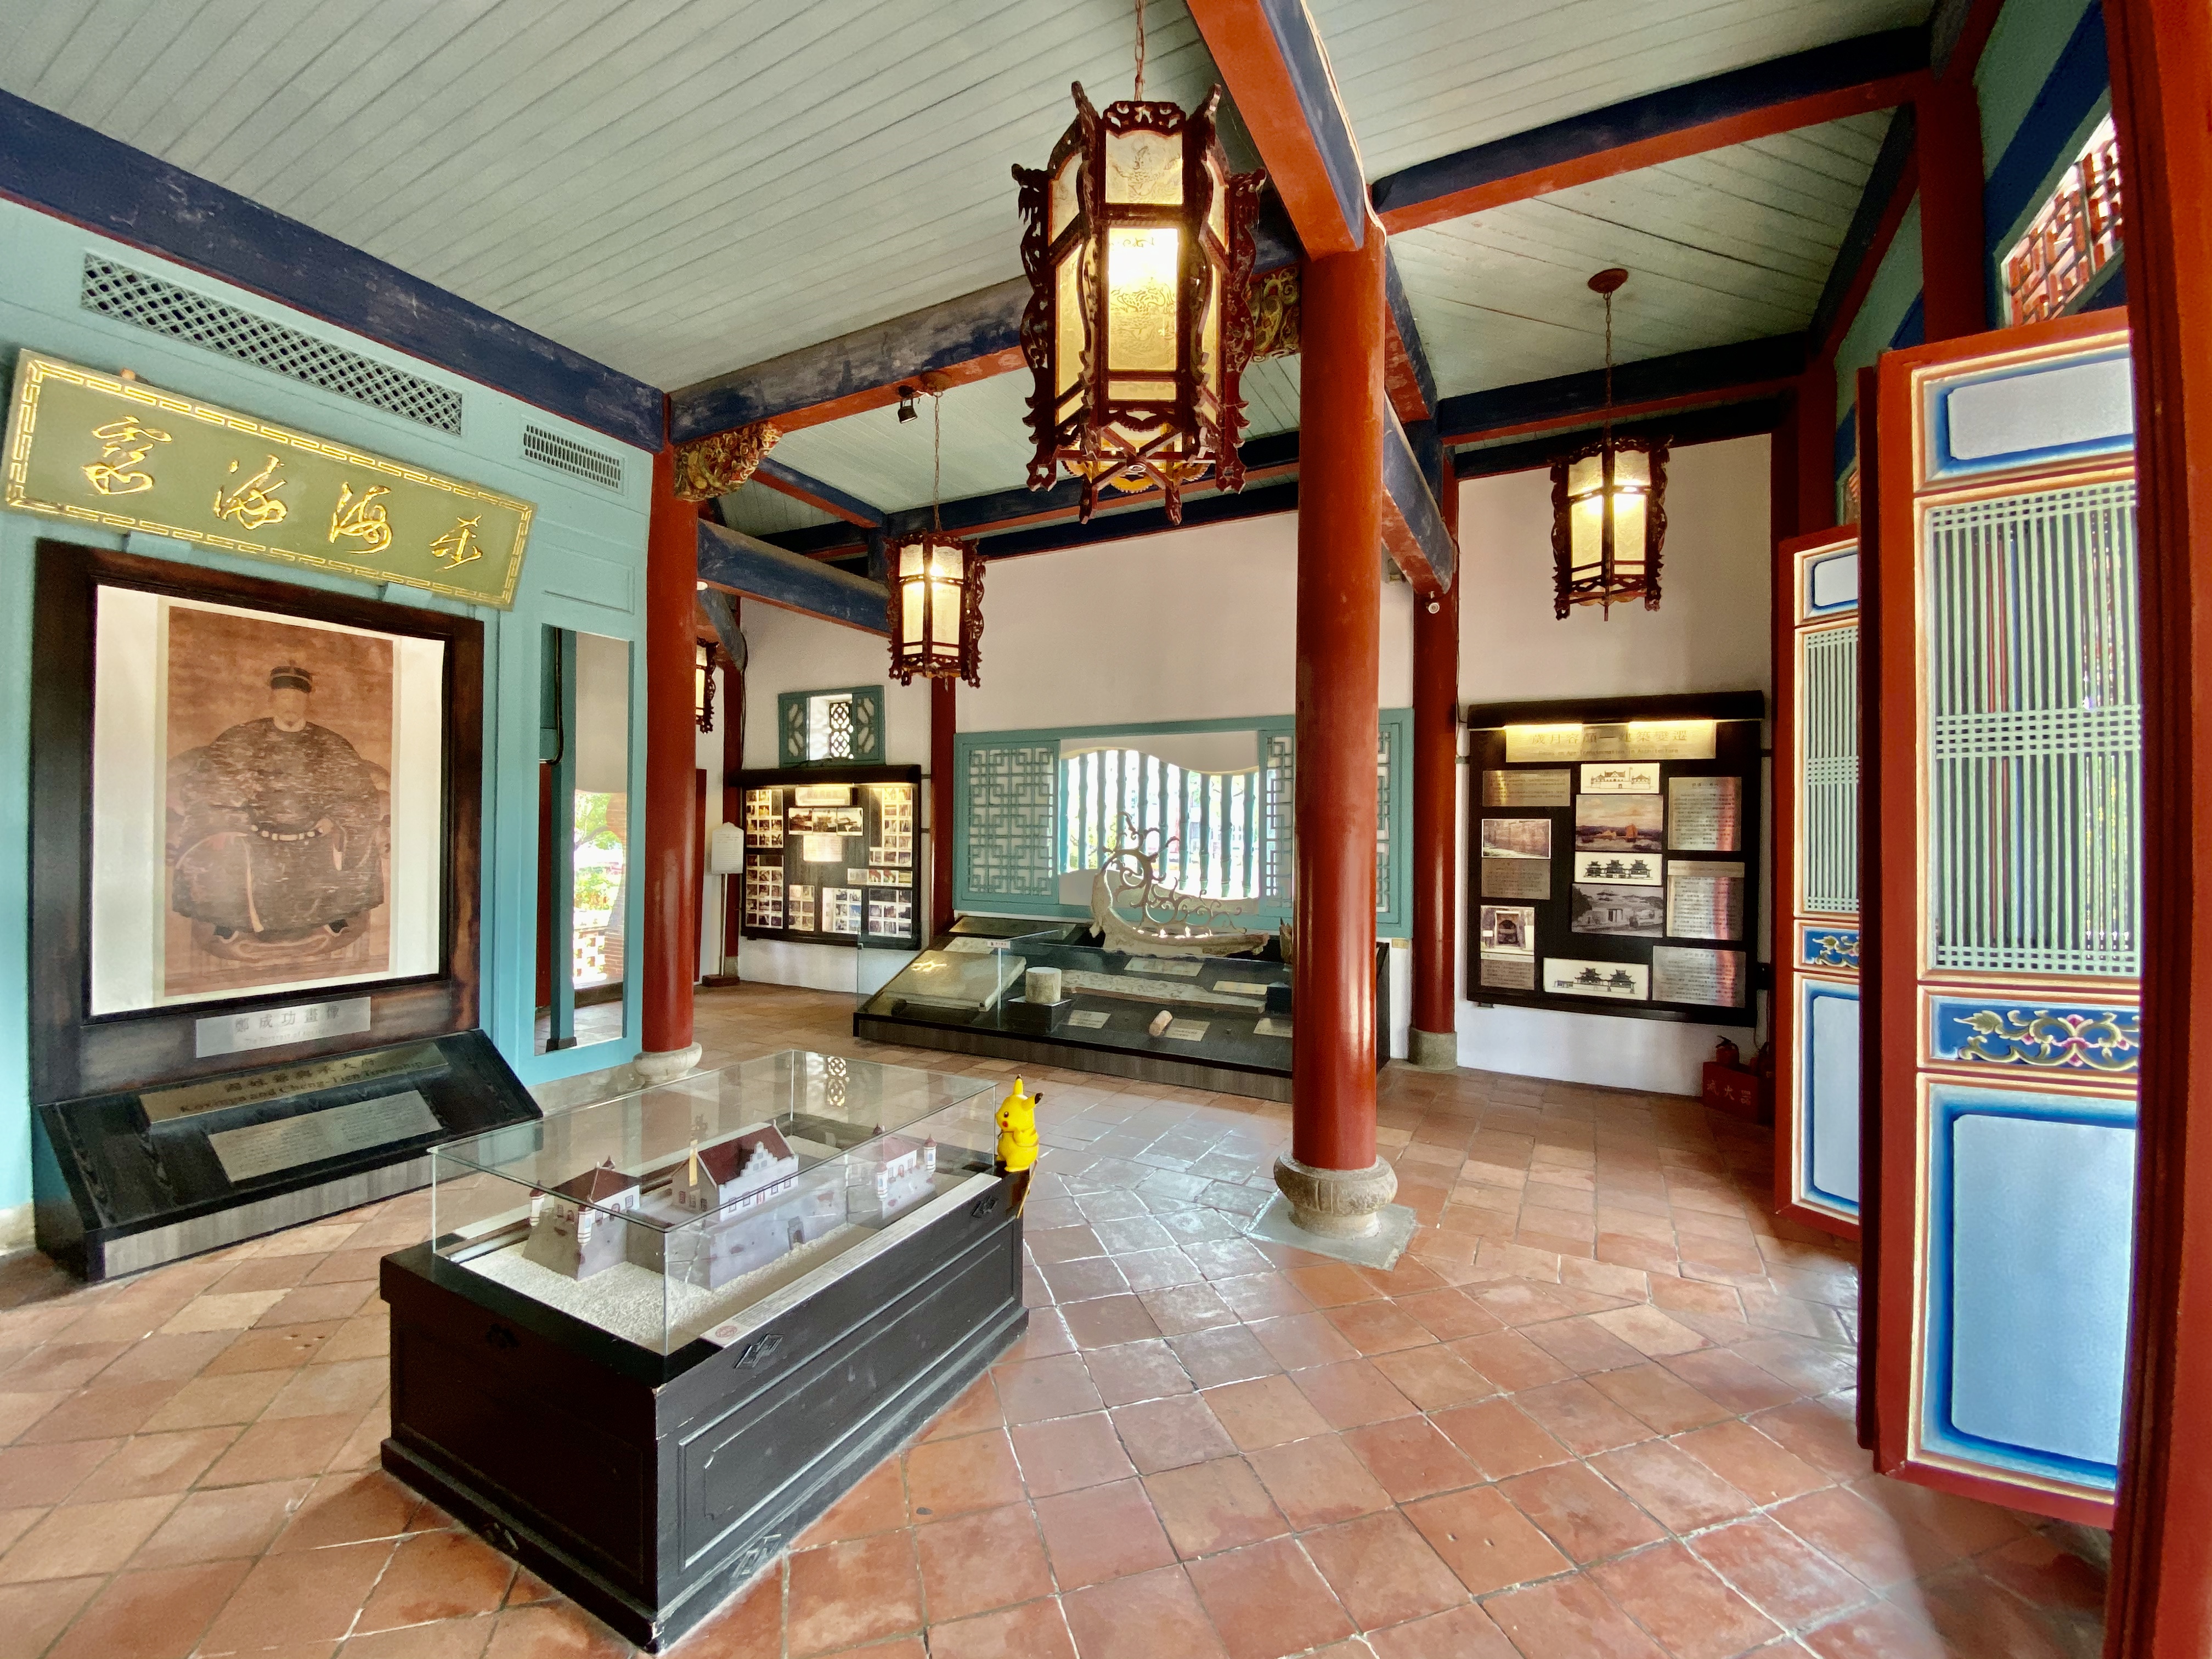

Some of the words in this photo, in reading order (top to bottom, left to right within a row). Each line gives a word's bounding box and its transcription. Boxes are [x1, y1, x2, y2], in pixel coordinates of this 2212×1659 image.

[235, 1006, 340, 1032] 鄭成功畫像
